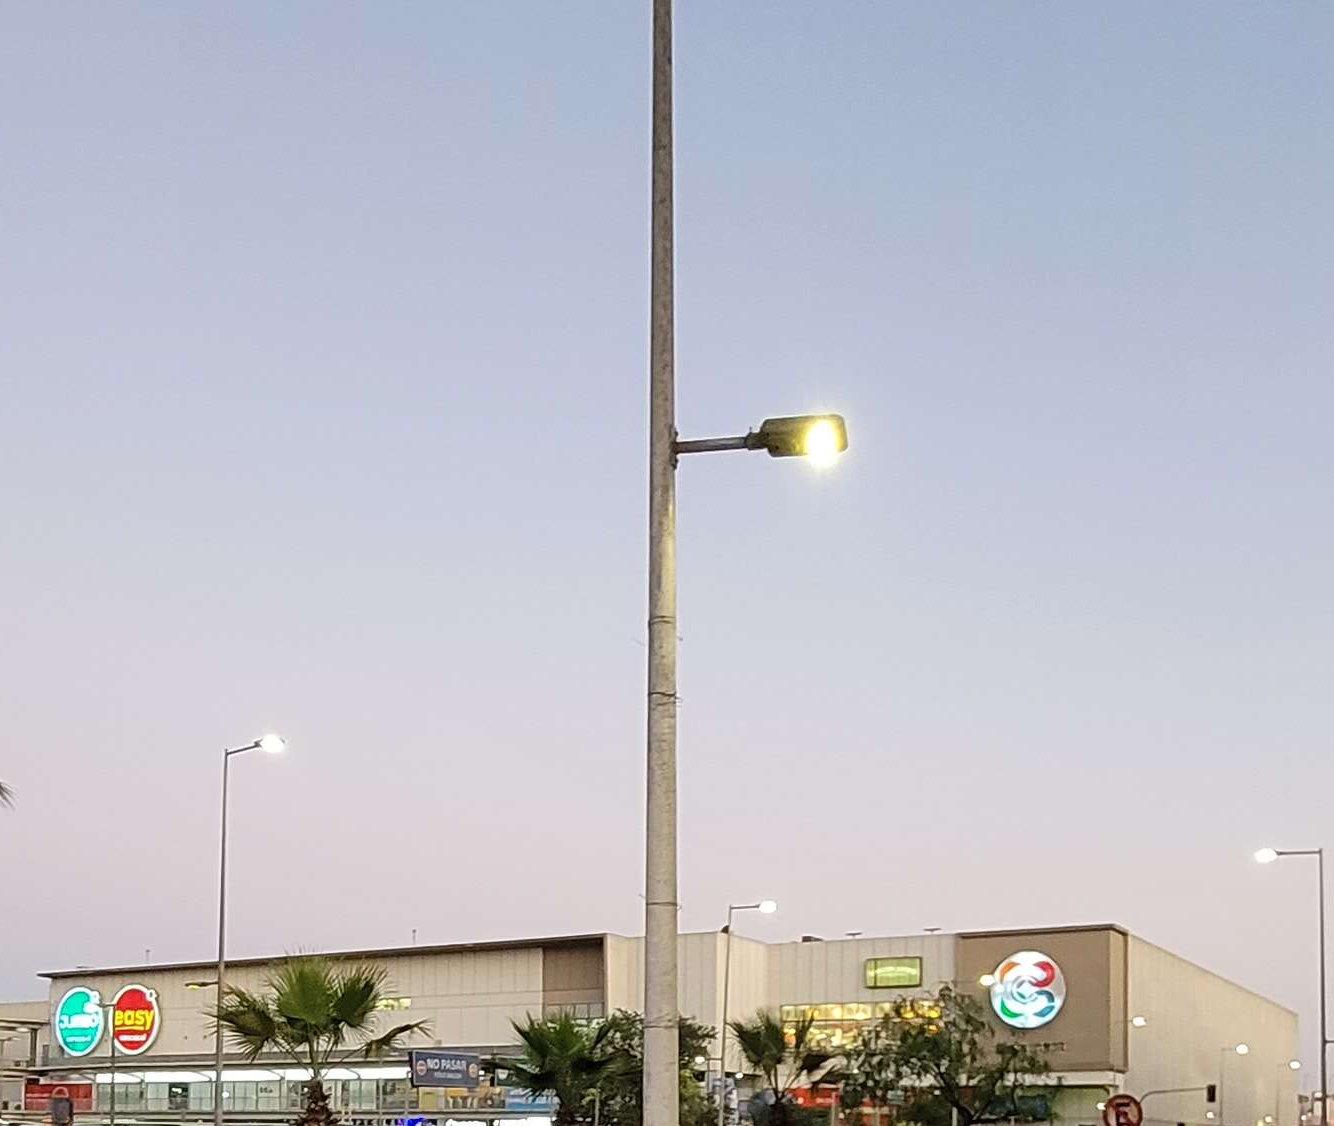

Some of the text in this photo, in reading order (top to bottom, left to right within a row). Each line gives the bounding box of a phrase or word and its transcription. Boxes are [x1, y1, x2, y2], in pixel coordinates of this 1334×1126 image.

[115, 1009, 155, 1031] easy
[426, 1058, 467, 1071] NO PASAR
[1115, 1102, 1132, 1126] E
